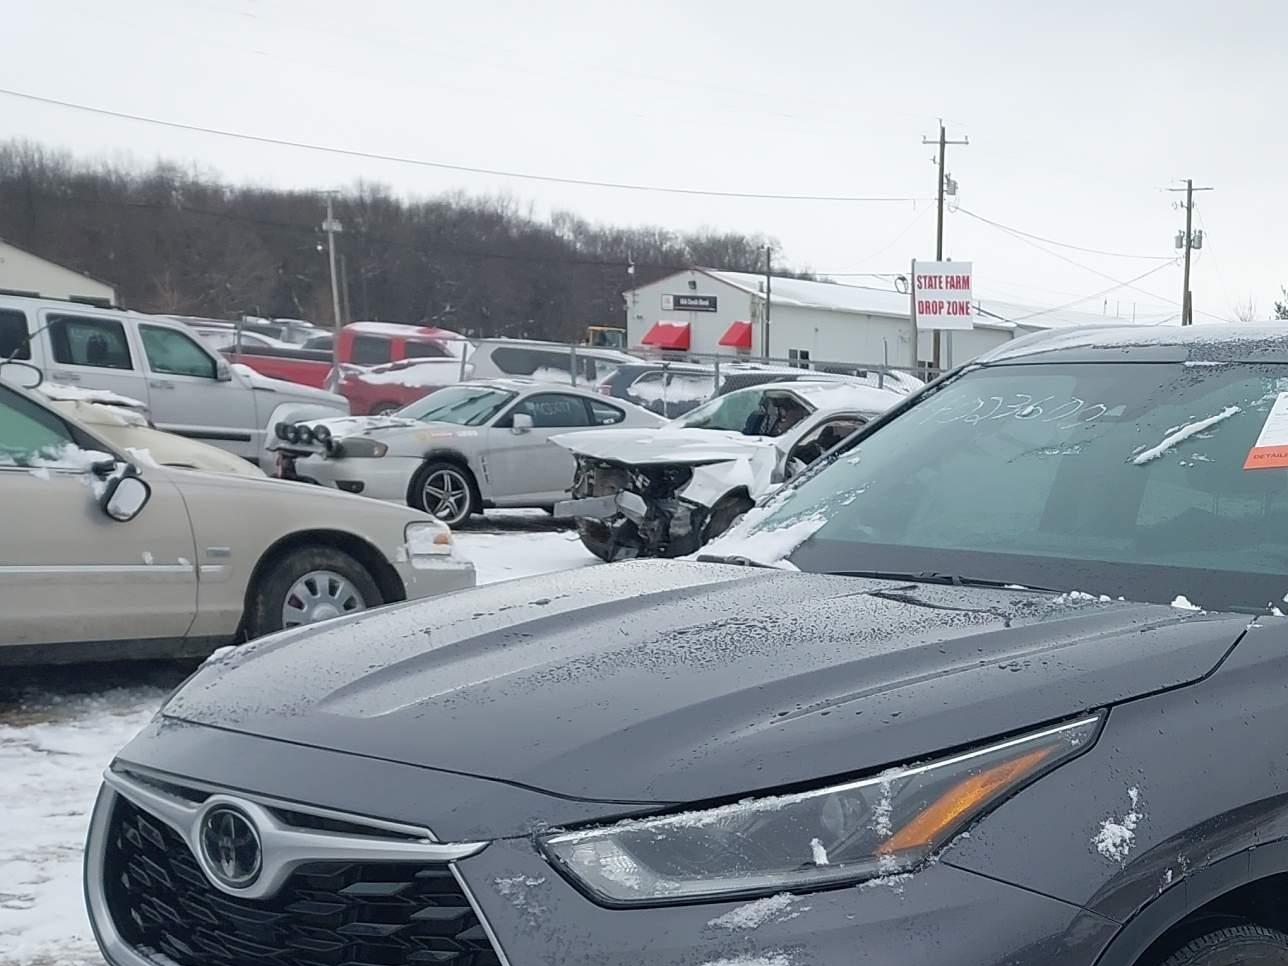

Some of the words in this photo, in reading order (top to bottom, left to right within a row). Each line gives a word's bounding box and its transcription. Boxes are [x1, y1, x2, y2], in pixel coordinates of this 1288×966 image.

[917, 275, 943, 290] STATE
[945, 275, 970, 290] FARM
[918, 300, 944, 315] DROP
[946, 301, 970, 316] ZONE
